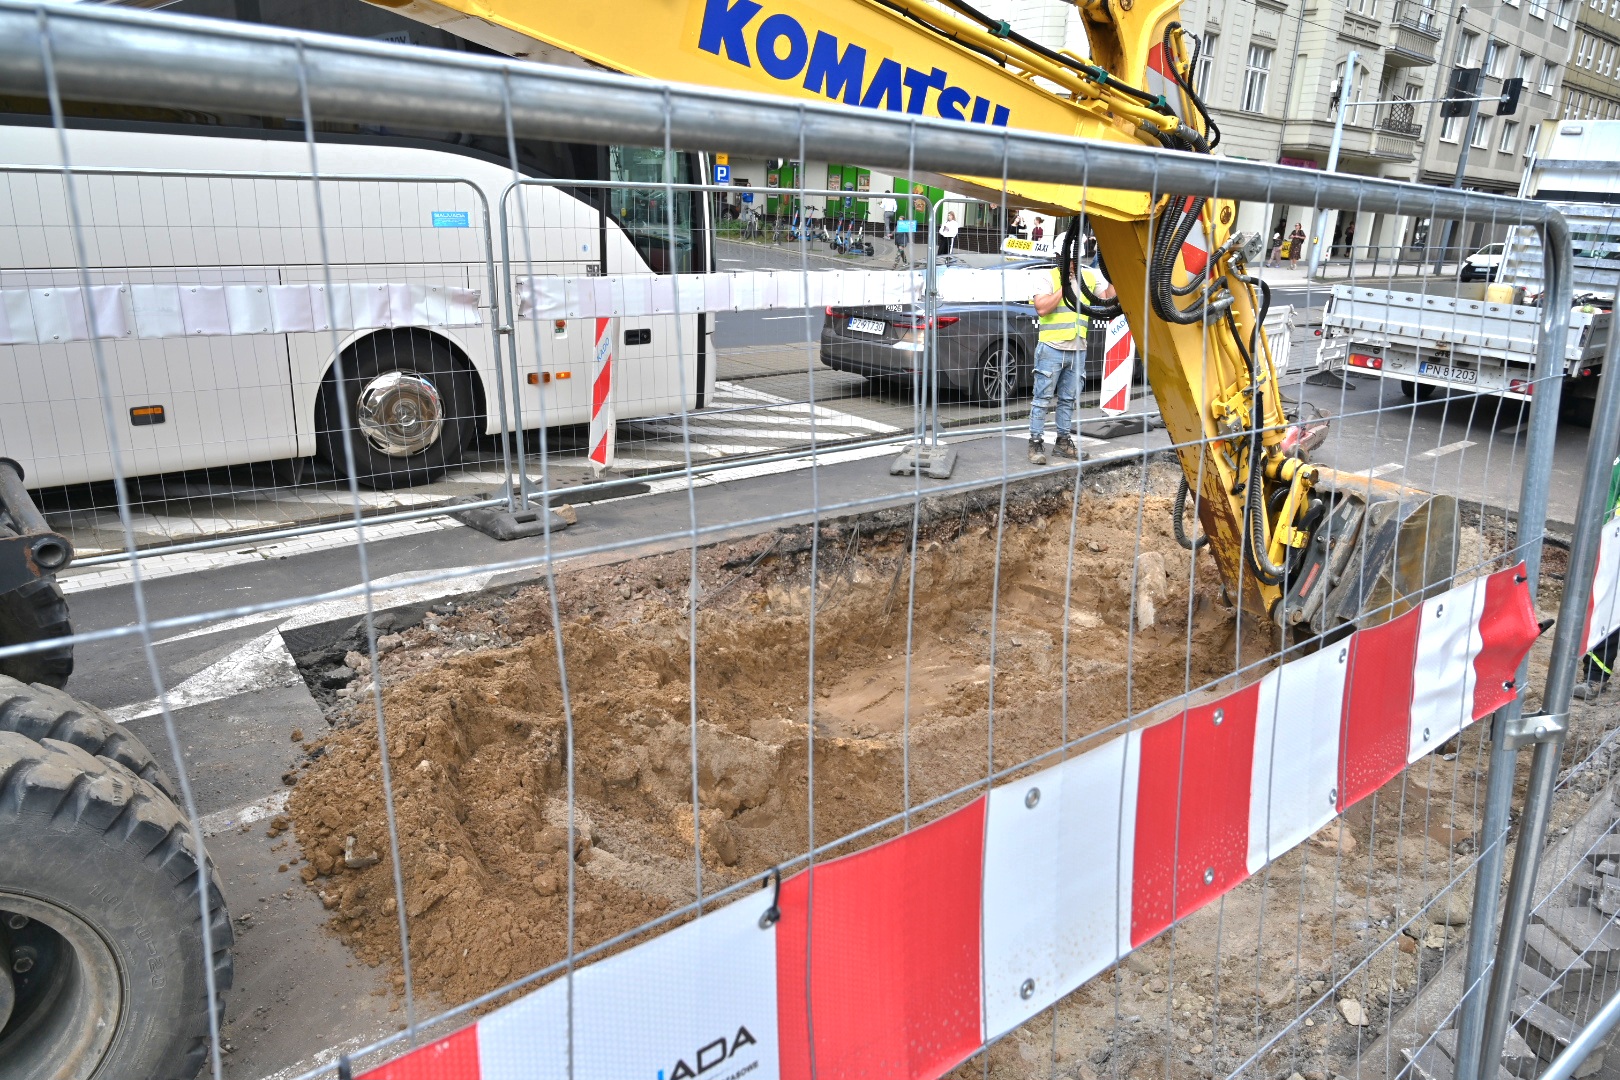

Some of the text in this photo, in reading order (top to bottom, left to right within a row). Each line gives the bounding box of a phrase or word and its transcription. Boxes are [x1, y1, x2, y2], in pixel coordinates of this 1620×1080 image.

[717, 166, 727, 181] P
[1034, 242, 1050, 253] TAXI
[1425, 364, 1477, 381] PN 81203
